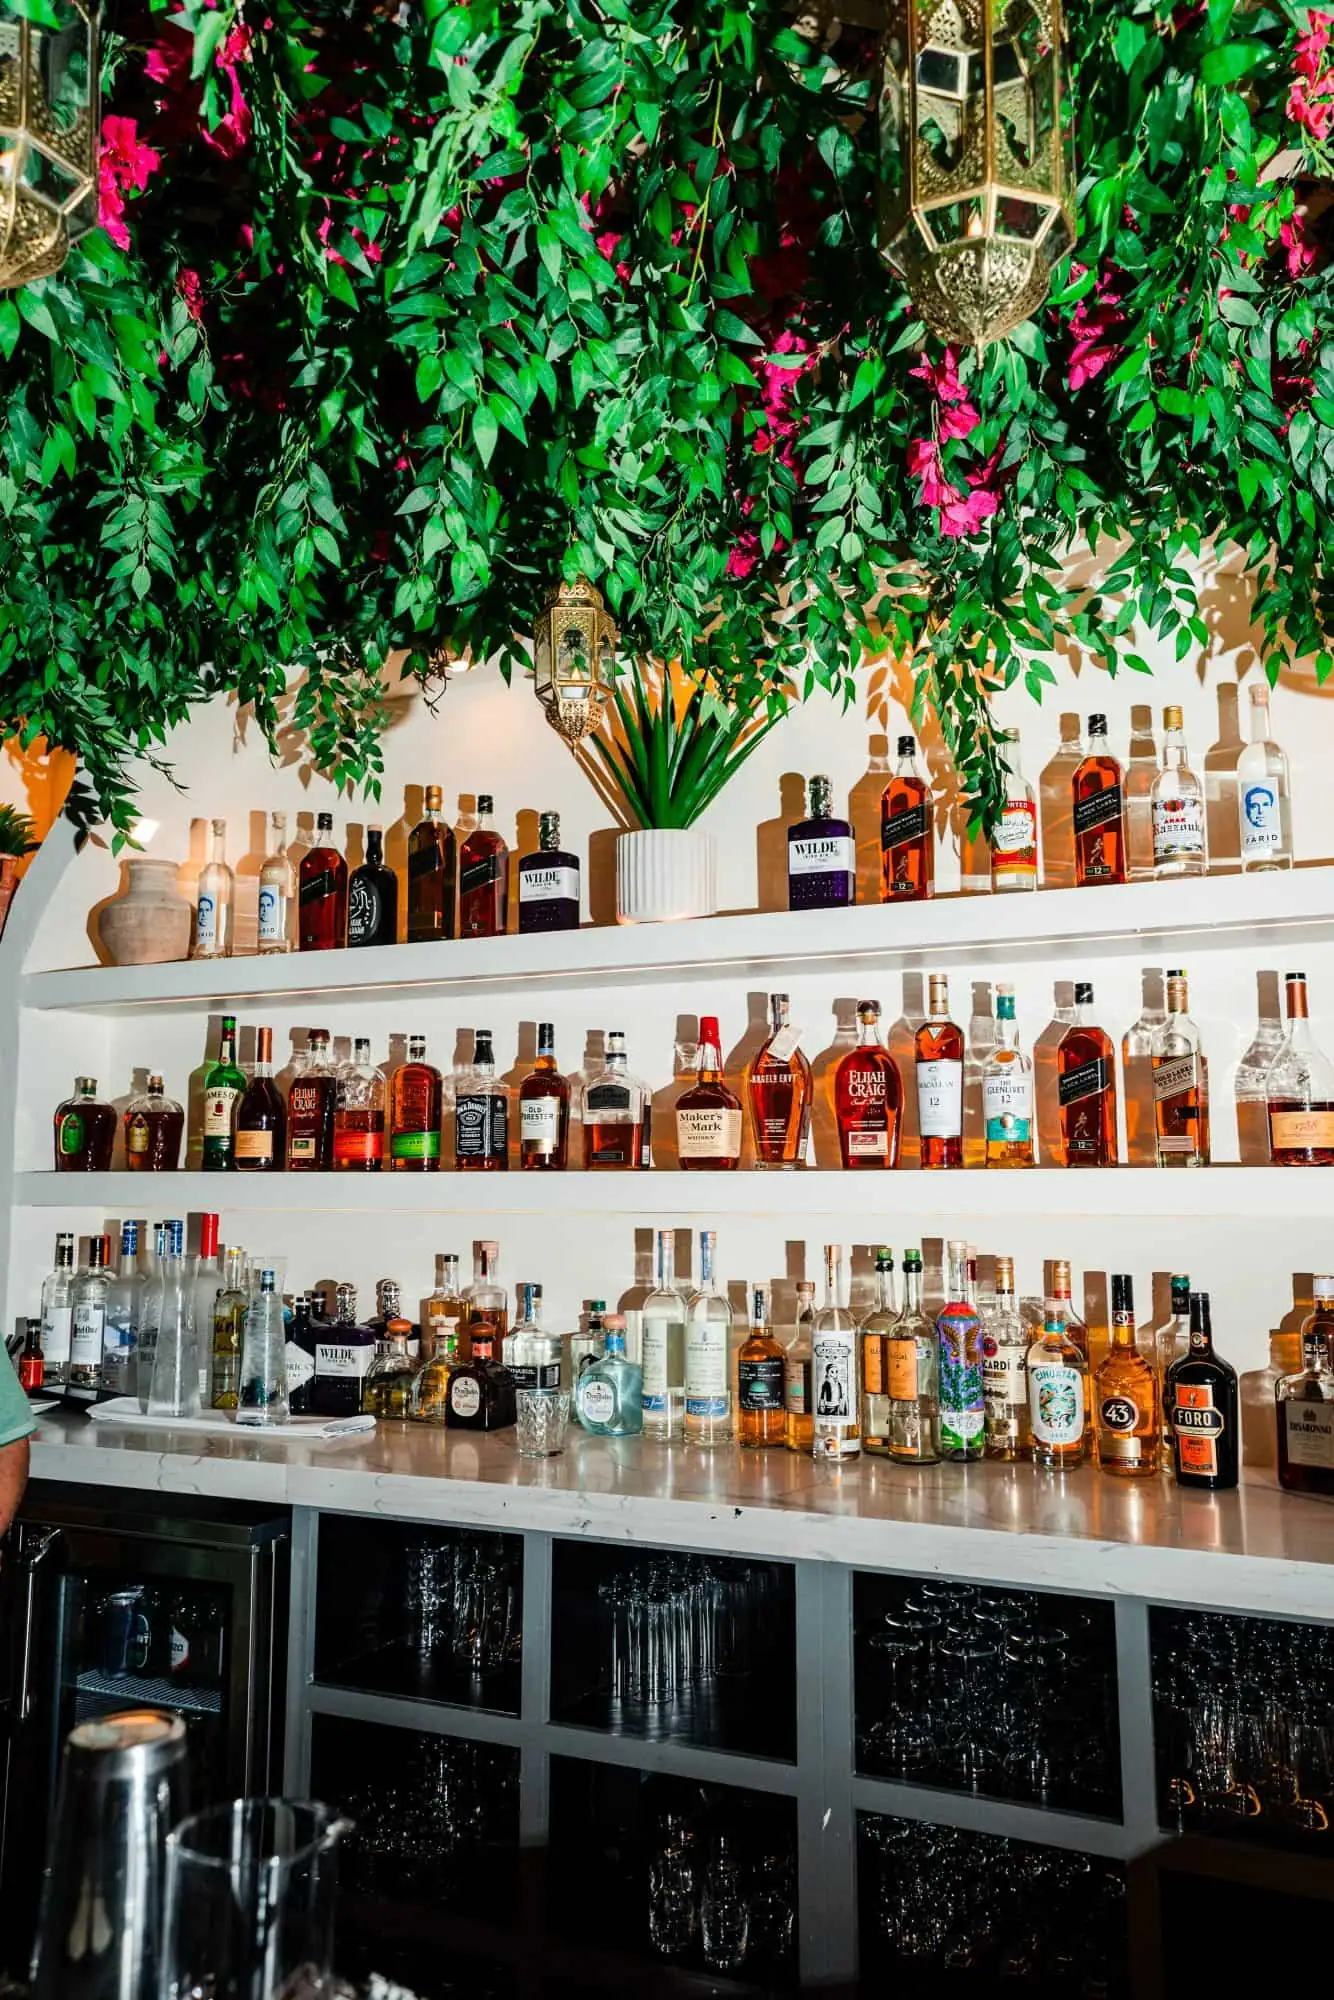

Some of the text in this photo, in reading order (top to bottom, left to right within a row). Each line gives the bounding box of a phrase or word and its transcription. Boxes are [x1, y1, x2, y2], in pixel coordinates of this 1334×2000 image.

[1246, 834, 1278, 845] FARID
[794, 841, 837, 855] WILDE
[524, 871, 560, 884] WILDE
[847, 1070, 887, 1084] ELIJAH
[207, 1090, 235, 1100] AMESO
[294, 1087, 316, 1099] ELIJAH
[847, 1083, 887, 1098] CRAIG
[987, 1086, 1025, 1095] GLENLIVET
[293, 1098, 316, 1110] CRAIG
[929, 1096, 941, 1106] 12
[1001, 1095, 1012, 1104] 12
[679, 1112, 723, 1122] Maker's
[691, 1122, 723, 1131] Mark
[1077, 1141, 1087, 1149] 12
[320, 1348, 354, 1359] WILDE
[983, 1358, 1010, 1371] CARDÍ
[1105, 1404, 1130, 1424] 43
[1177, 1410, 1213, 1427] FORO
